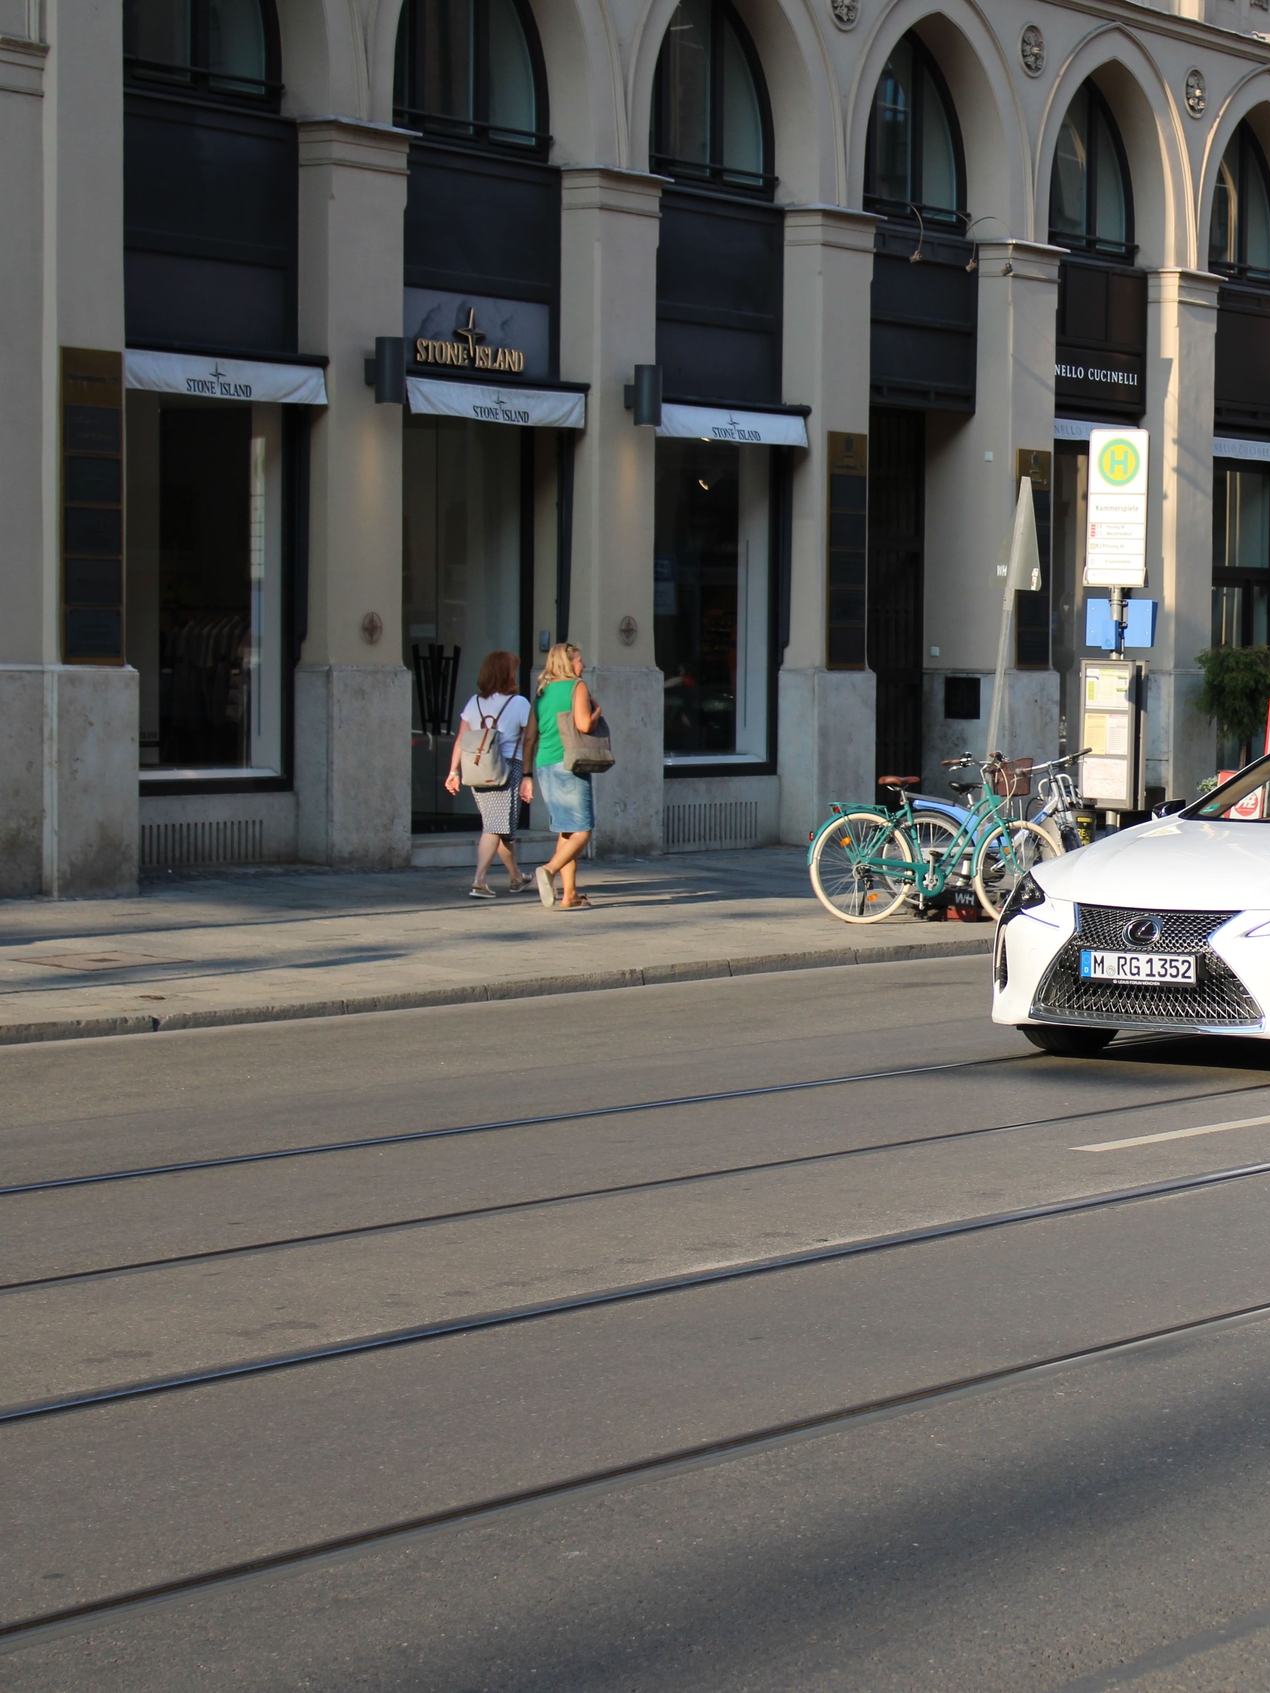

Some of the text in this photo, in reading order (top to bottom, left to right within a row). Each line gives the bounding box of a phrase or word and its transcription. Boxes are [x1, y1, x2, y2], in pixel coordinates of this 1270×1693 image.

[416, 338, 525, 373] STONE ISLAND
[1088, 368, 1138, 386] CUCINELLI
[186, 378, 252, 398] STONE ISLAND
[473, 405, 530, 424] STONE ISLAND
[712, 426, 762, 442] STONE ISLAND
[1110, 450, 1128, 475] H
[1095, 504, 1139, 514] Kammerspiele
[955, 892, 975, 906] WH
[1093, 955, 1192, 980] M RG 1352
